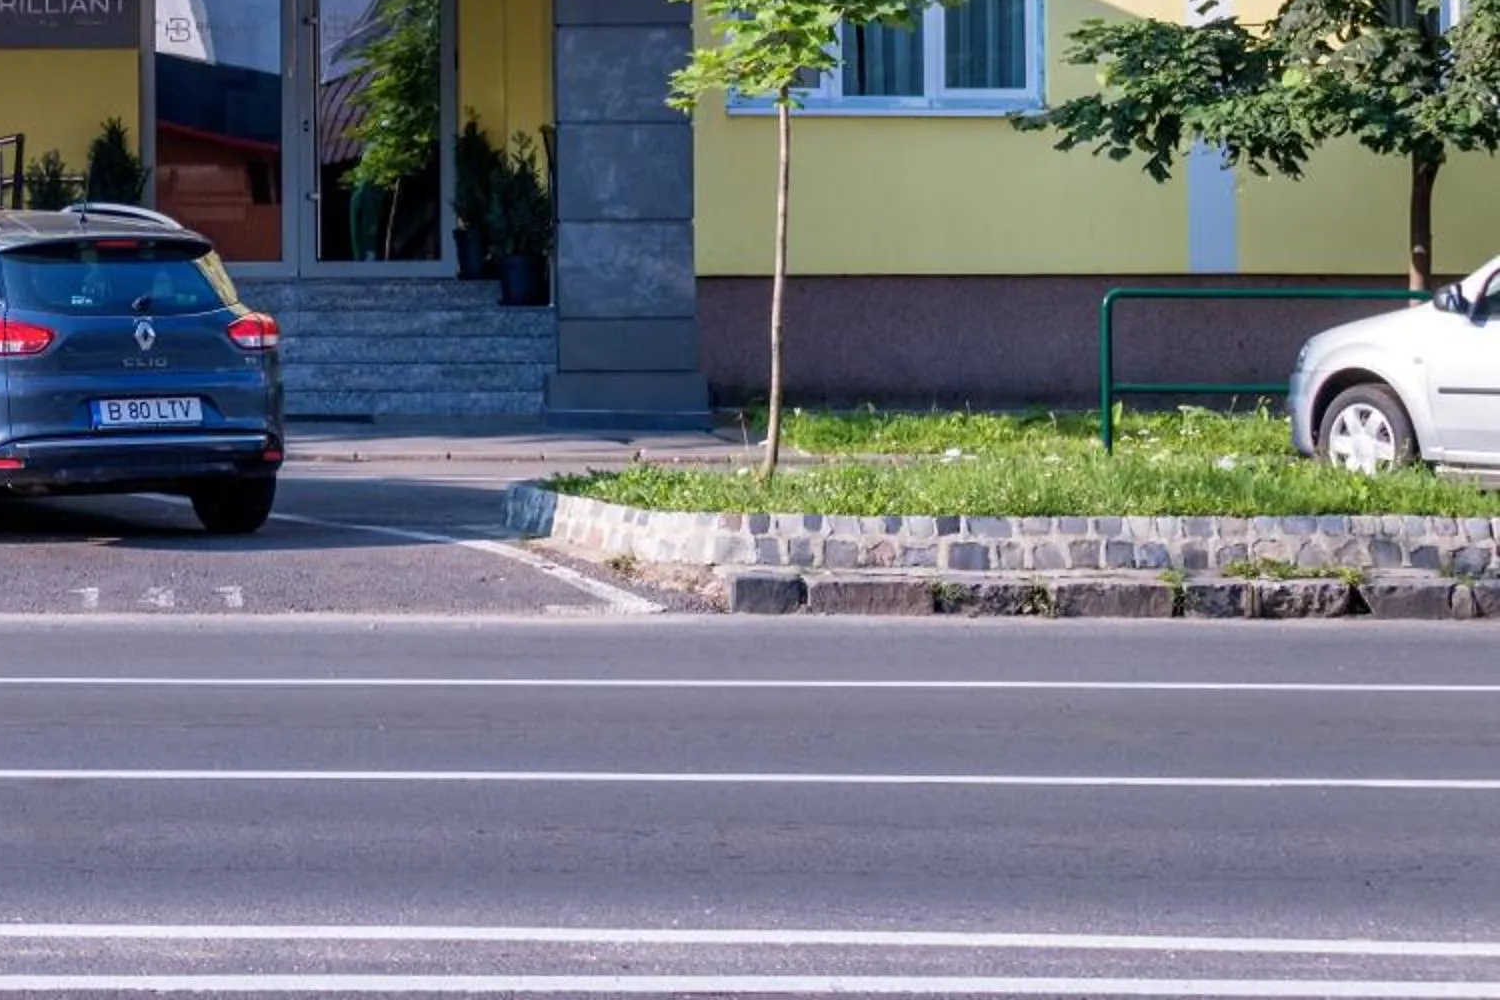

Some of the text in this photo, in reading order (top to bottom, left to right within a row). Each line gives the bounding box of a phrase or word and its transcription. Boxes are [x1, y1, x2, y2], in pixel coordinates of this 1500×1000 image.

[122, 357, 168, 367] CLIO
[108, 401, 191, 420] B 80 LTV
